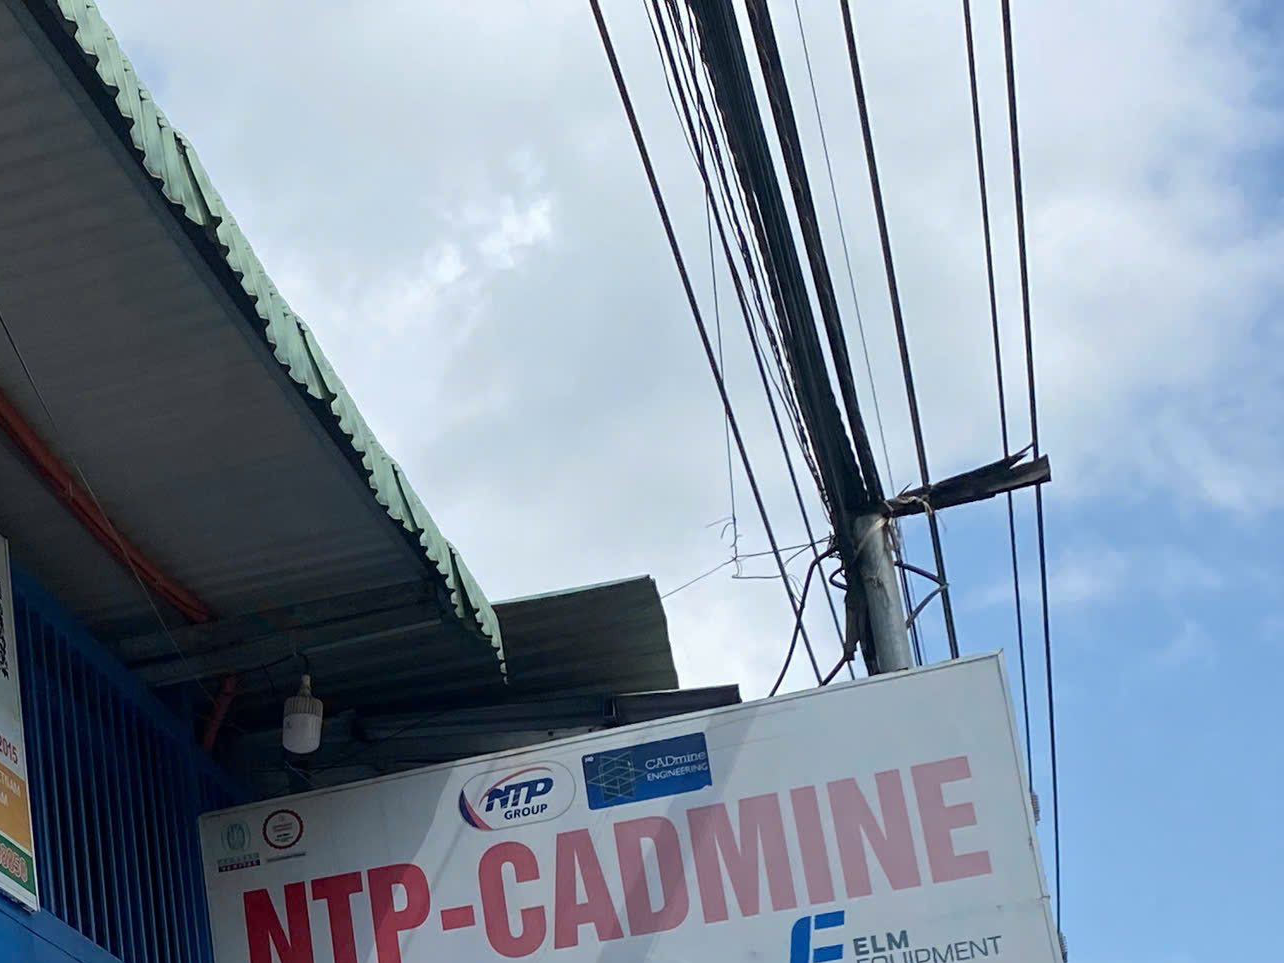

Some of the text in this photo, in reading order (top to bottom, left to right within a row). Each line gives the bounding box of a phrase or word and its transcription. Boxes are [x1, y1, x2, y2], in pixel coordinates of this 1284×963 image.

[645, 750, 706, 770] CADmine
[646, 762, 708, 782] ENGINEERING
[485, 777, 553, 812] NTP
[504, 803, 548, 820] GROUP
[853, 930, 909, 956] ELM
